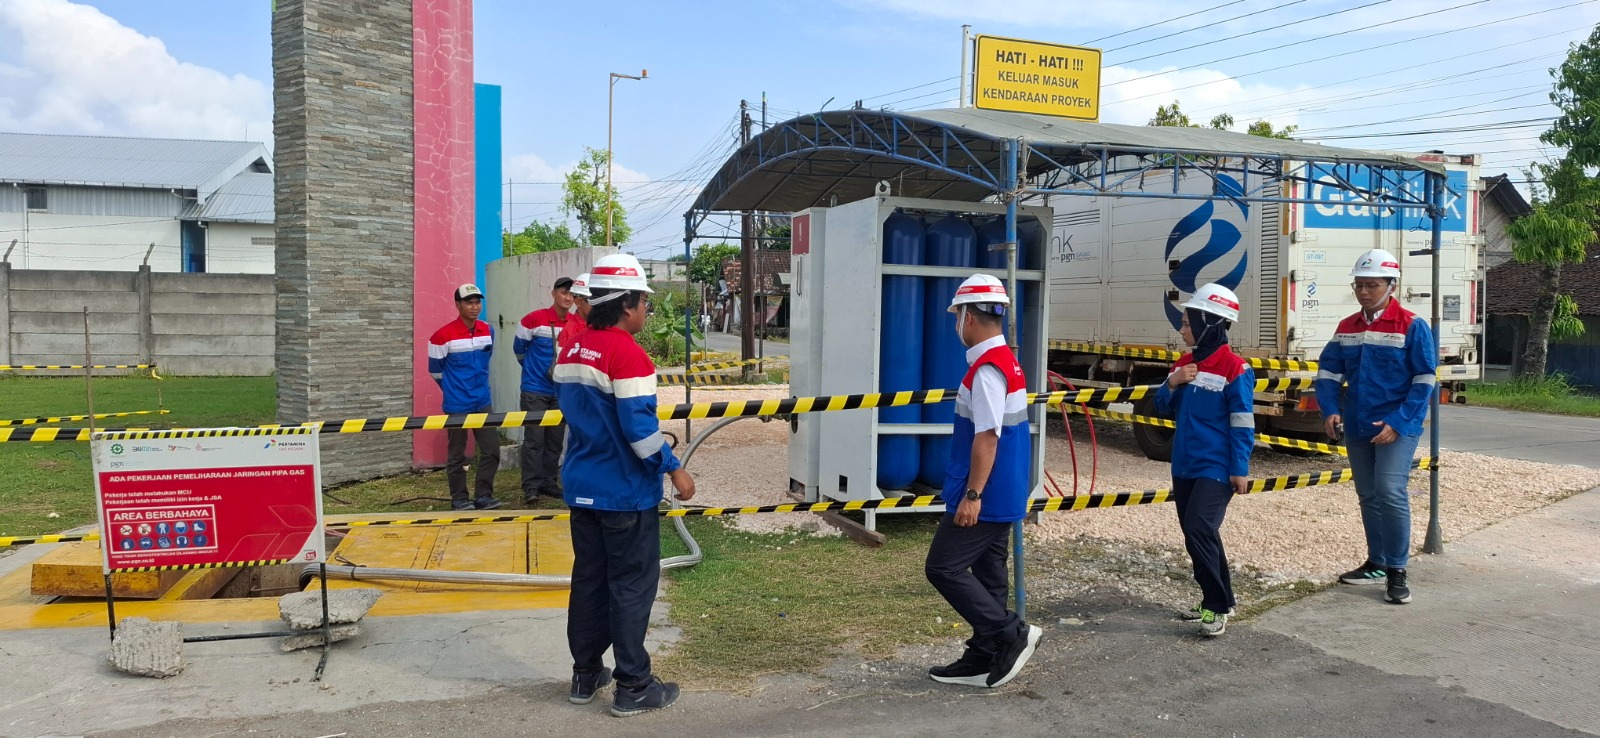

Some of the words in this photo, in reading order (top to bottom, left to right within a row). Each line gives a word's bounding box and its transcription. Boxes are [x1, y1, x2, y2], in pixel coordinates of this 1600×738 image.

[996, 50, 1027, 65] HATI
[1039, 55, 1068, 70] HATI
[1072, 58, 1084, 71] !!!
[998, 70, 1040, 85] KELUAR
[1042, 75, 1079, 89] MASUK
[983, 87, 1048, 104] KENDARAAN
[1051, 94, 1092, 108] PROYEK
[1061, 252, 1075, 263] pgn
[1302, 299, 1319, 309] pgn
[127, 474, 172, 482] PEKERJAAN
[173, 472, 232, 480] PEMELIHARAAN
[233, 470, 271, 478] JARINGAN
[113, 512, 144, 521] AREA
[145, 509, 209, 519] BERBAHAYA
